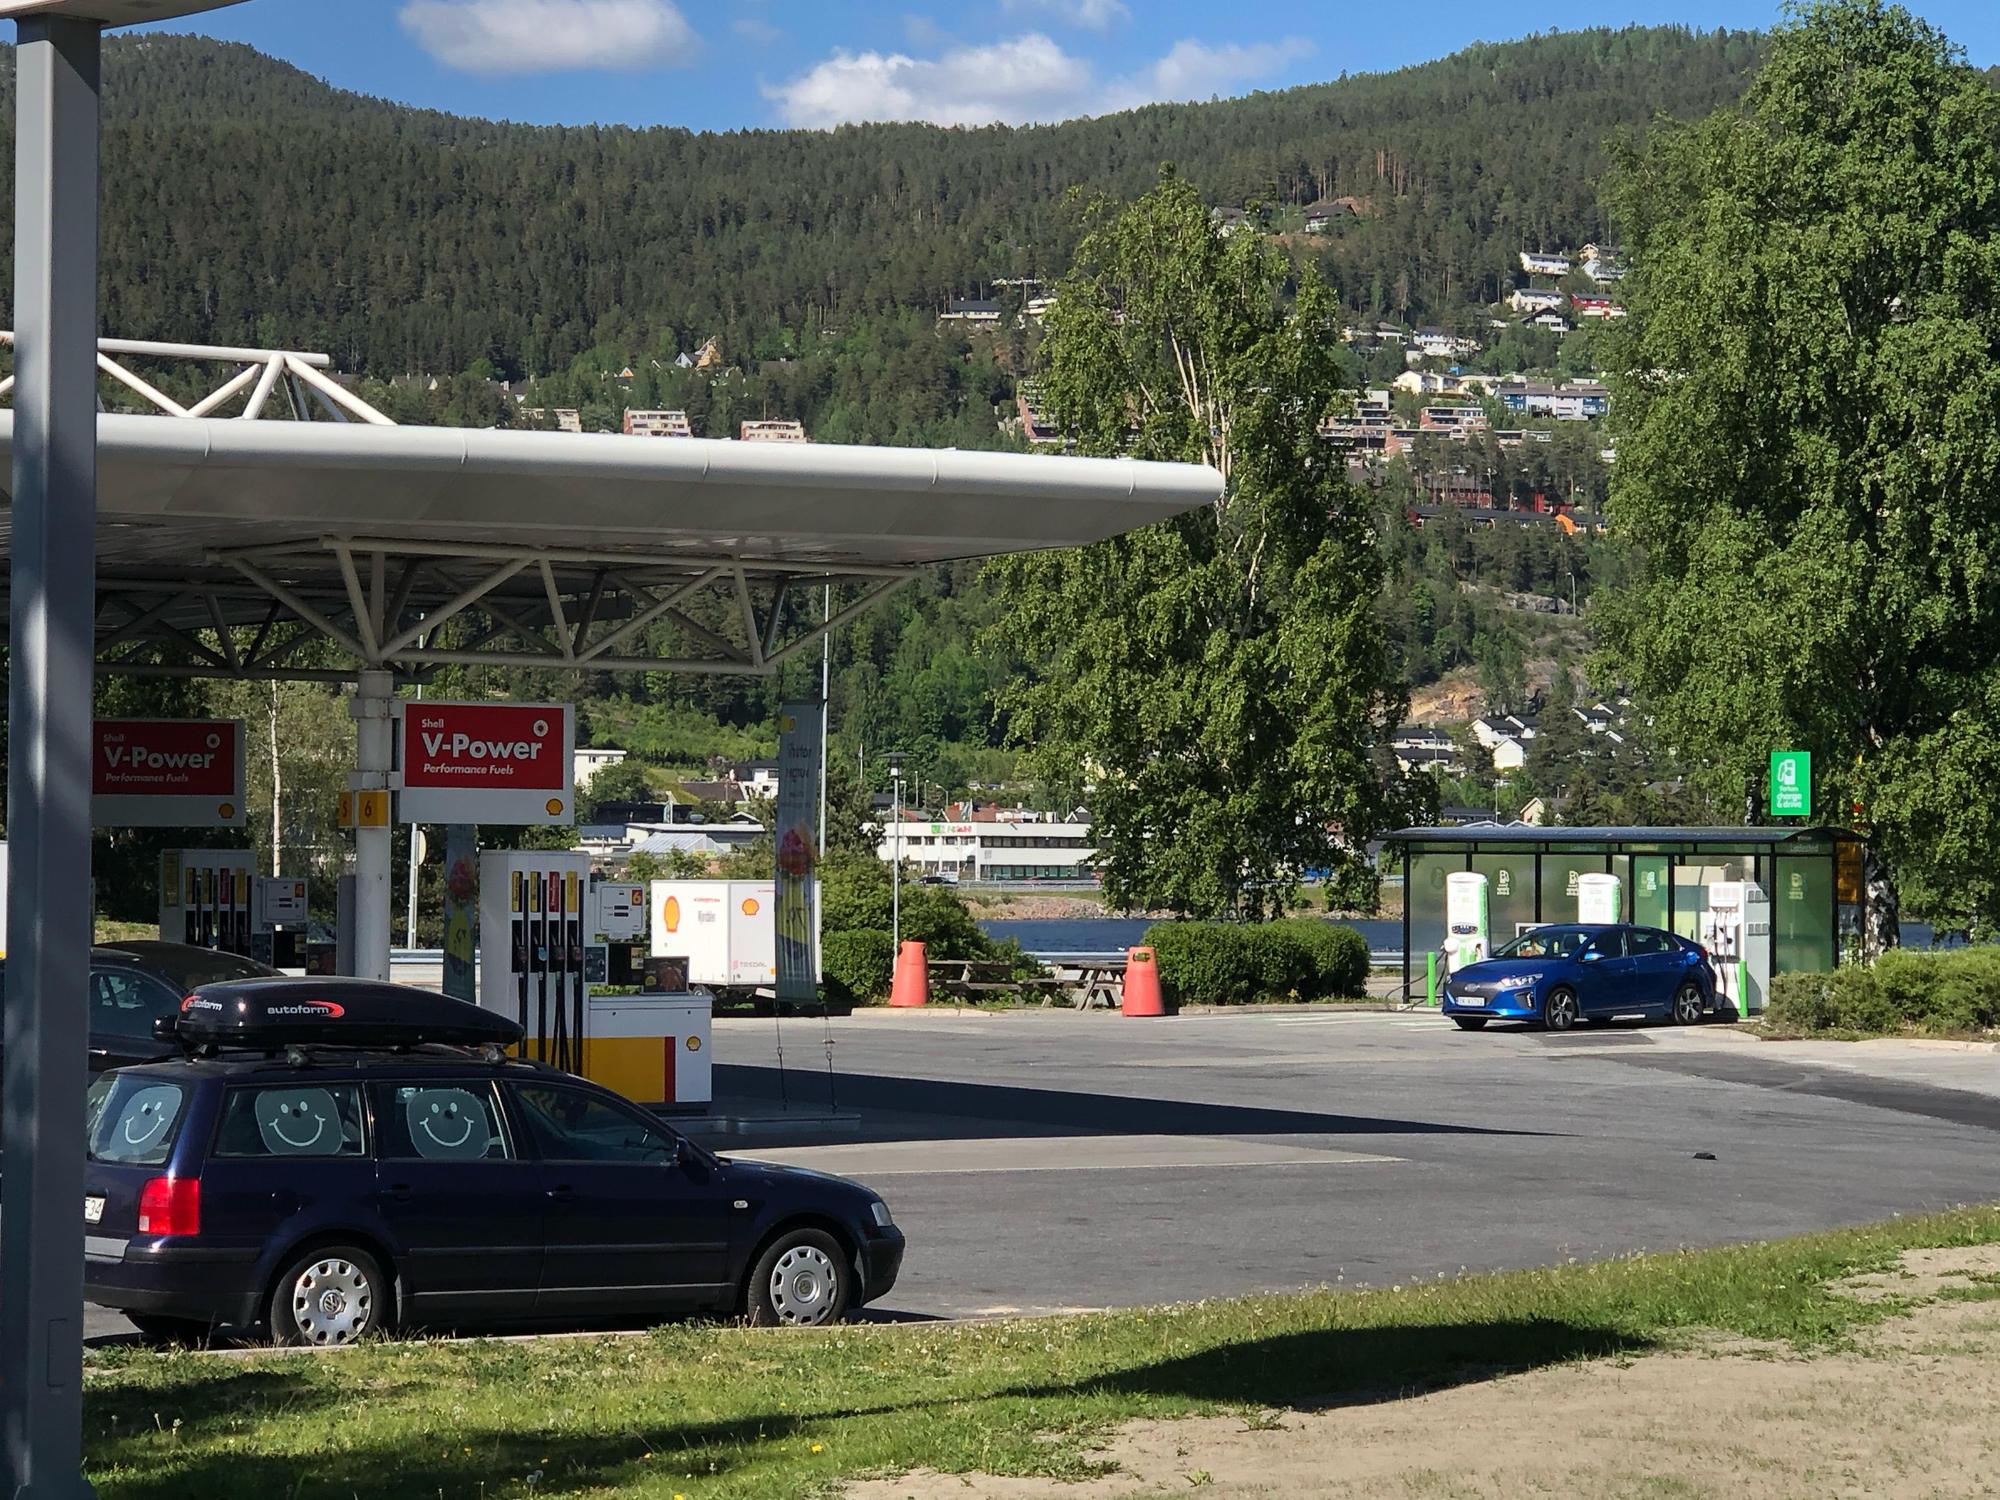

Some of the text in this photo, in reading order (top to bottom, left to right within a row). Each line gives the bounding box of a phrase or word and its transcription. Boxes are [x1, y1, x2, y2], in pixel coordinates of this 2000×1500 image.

[421, 719, 444, 728] Shell
[103, 734, 125, 742] Shell
[421, 732, 542, 760] V-Power
[103, 746, 215, 769] V-Power
[423, 763, 514, 775] Performance Fuels
[105, 773, 189, 782] Performance Fuels
[342, 800, 349, 817] 5
[364, 800, 372, 817] 6
[633, 891, 642, 904] 6
[267, 1005, 329, 1015] autoform
